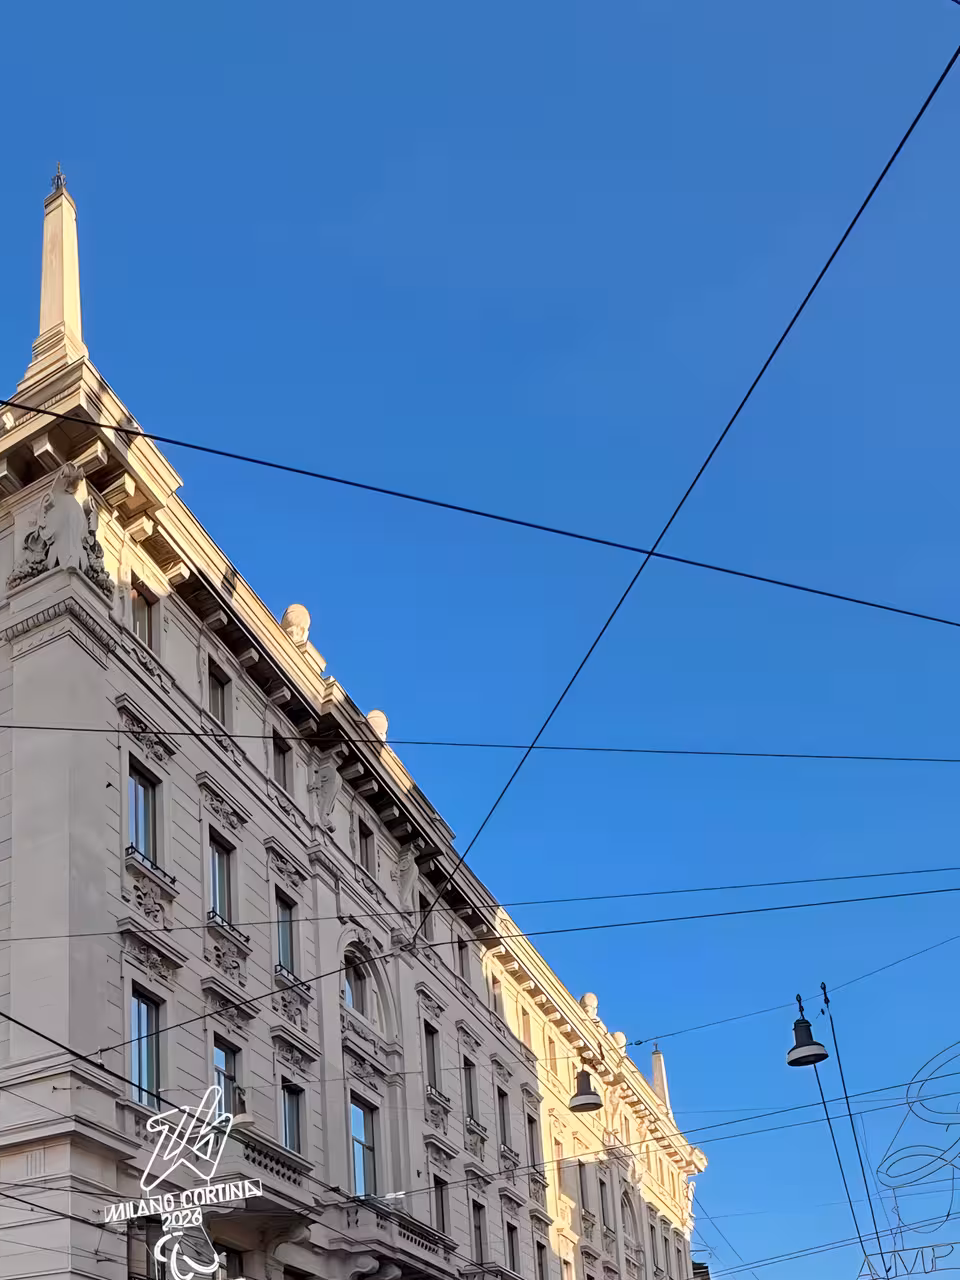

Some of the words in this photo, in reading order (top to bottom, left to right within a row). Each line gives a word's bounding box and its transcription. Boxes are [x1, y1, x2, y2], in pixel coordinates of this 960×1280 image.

[105, 1196, 176, 1222] MILANO
[180, 1179, 262, 1209] CORTINA
[161, 1207, 202, 1232] 2026
